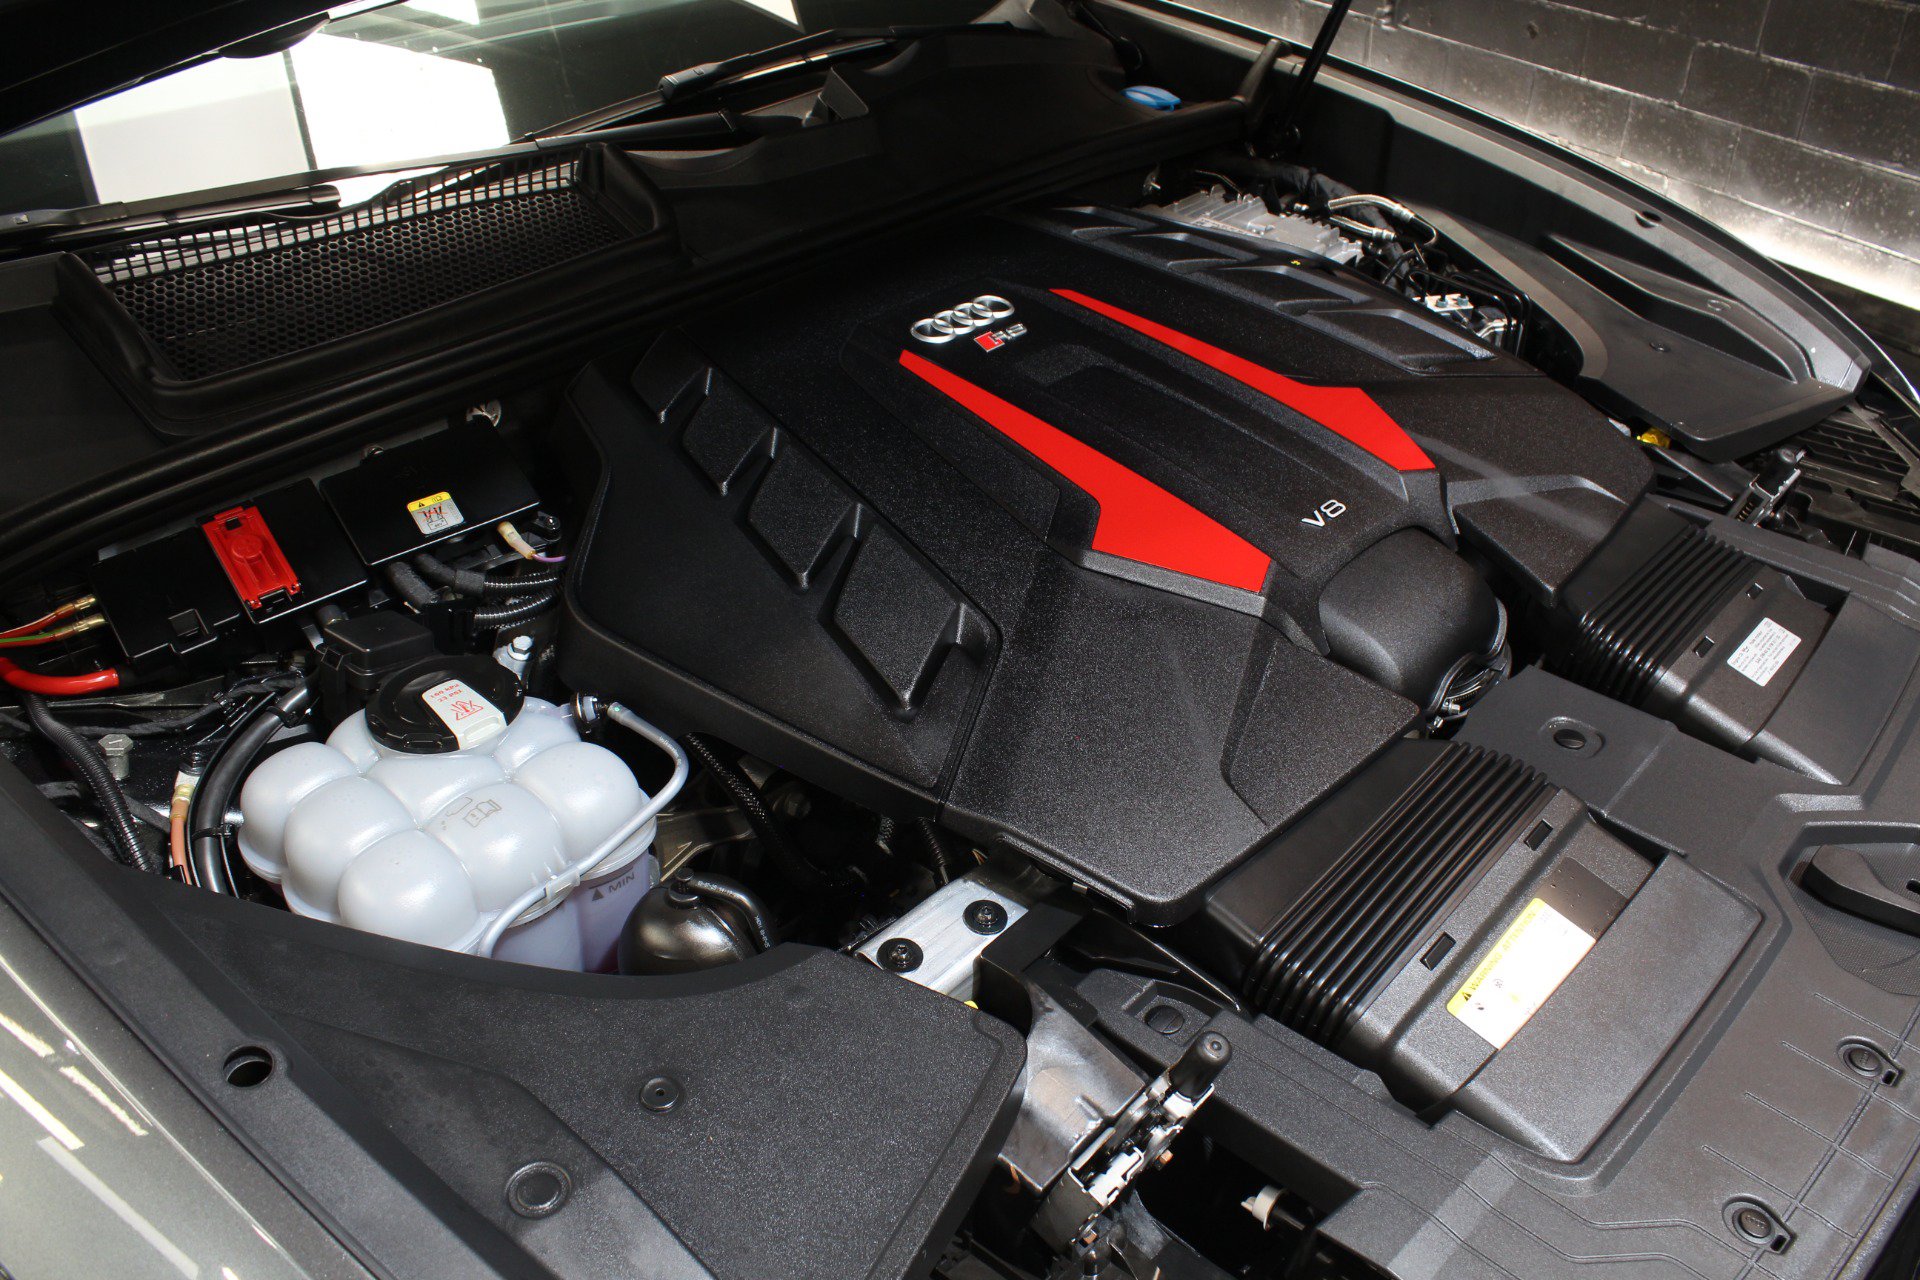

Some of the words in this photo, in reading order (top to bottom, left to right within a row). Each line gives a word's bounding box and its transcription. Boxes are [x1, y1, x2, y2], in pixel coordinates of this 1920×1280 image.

[1301, 499, 1346, 527] V8
[609, 872, 635, 893] MIN
[1469, 951, 1503, 991] WARNING
